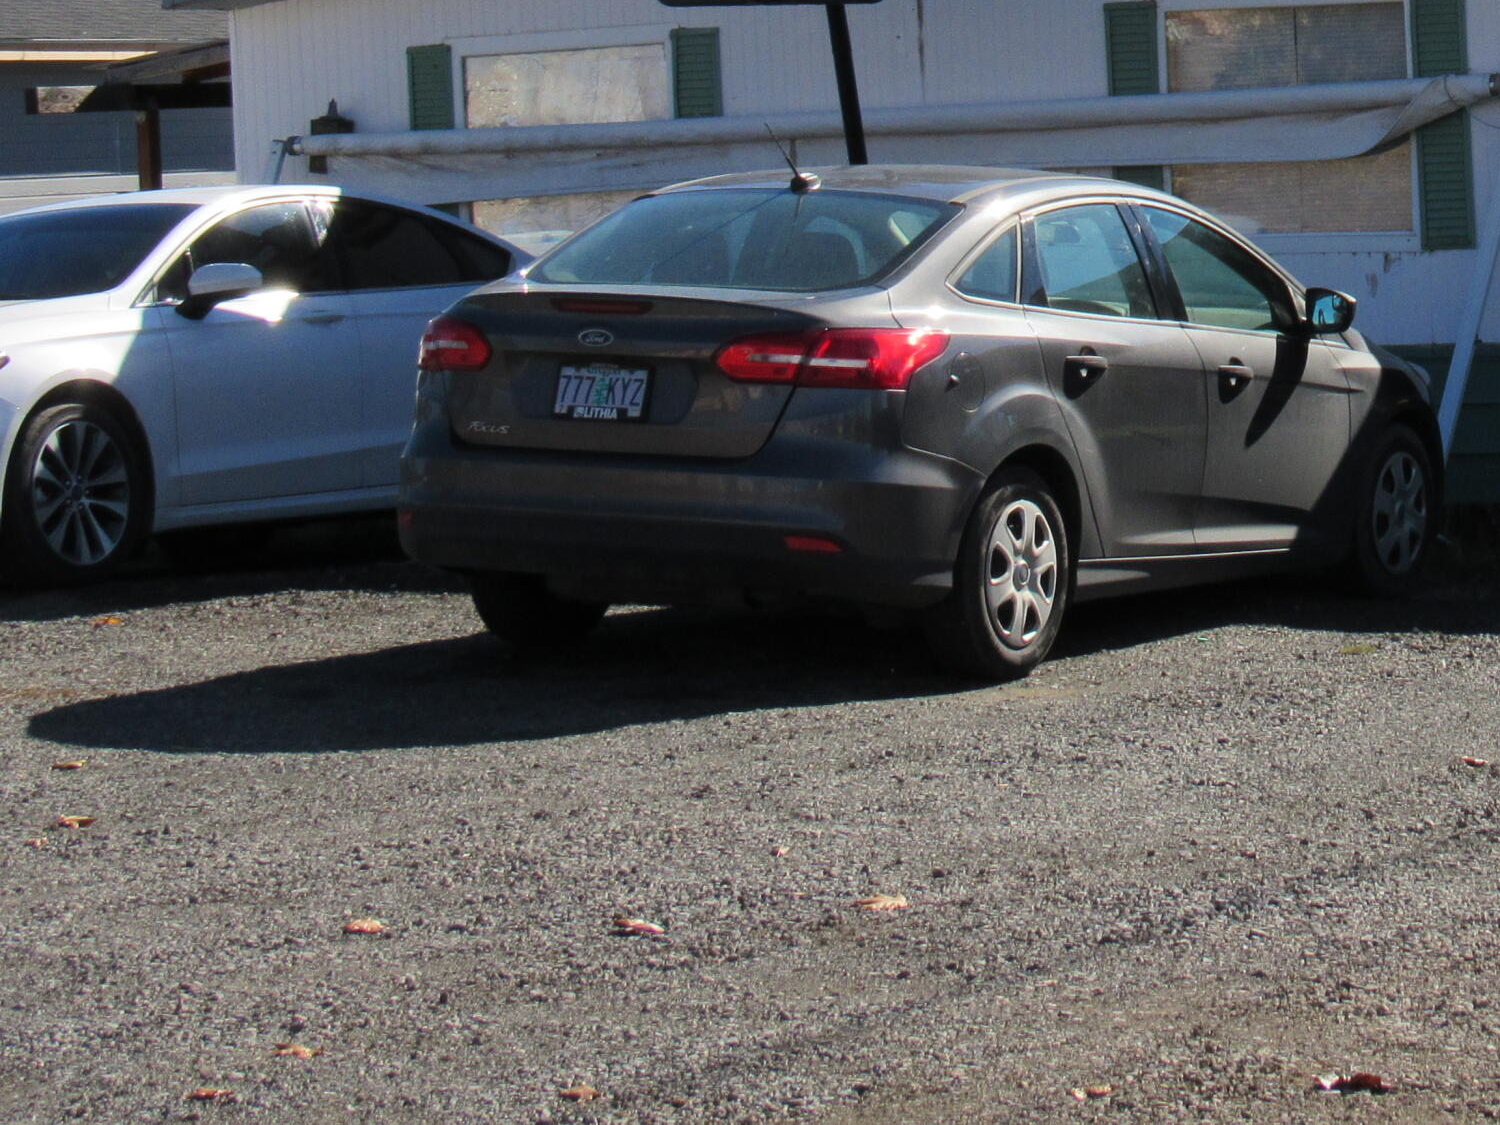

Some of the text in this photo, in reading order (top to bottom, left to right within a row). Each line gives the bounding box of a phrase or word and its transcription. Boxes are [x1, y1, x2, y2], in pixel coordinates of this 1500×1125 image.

[560, 375, 645, 407] 777 KYZ
[584, 407, 618, 420] LITHIA
